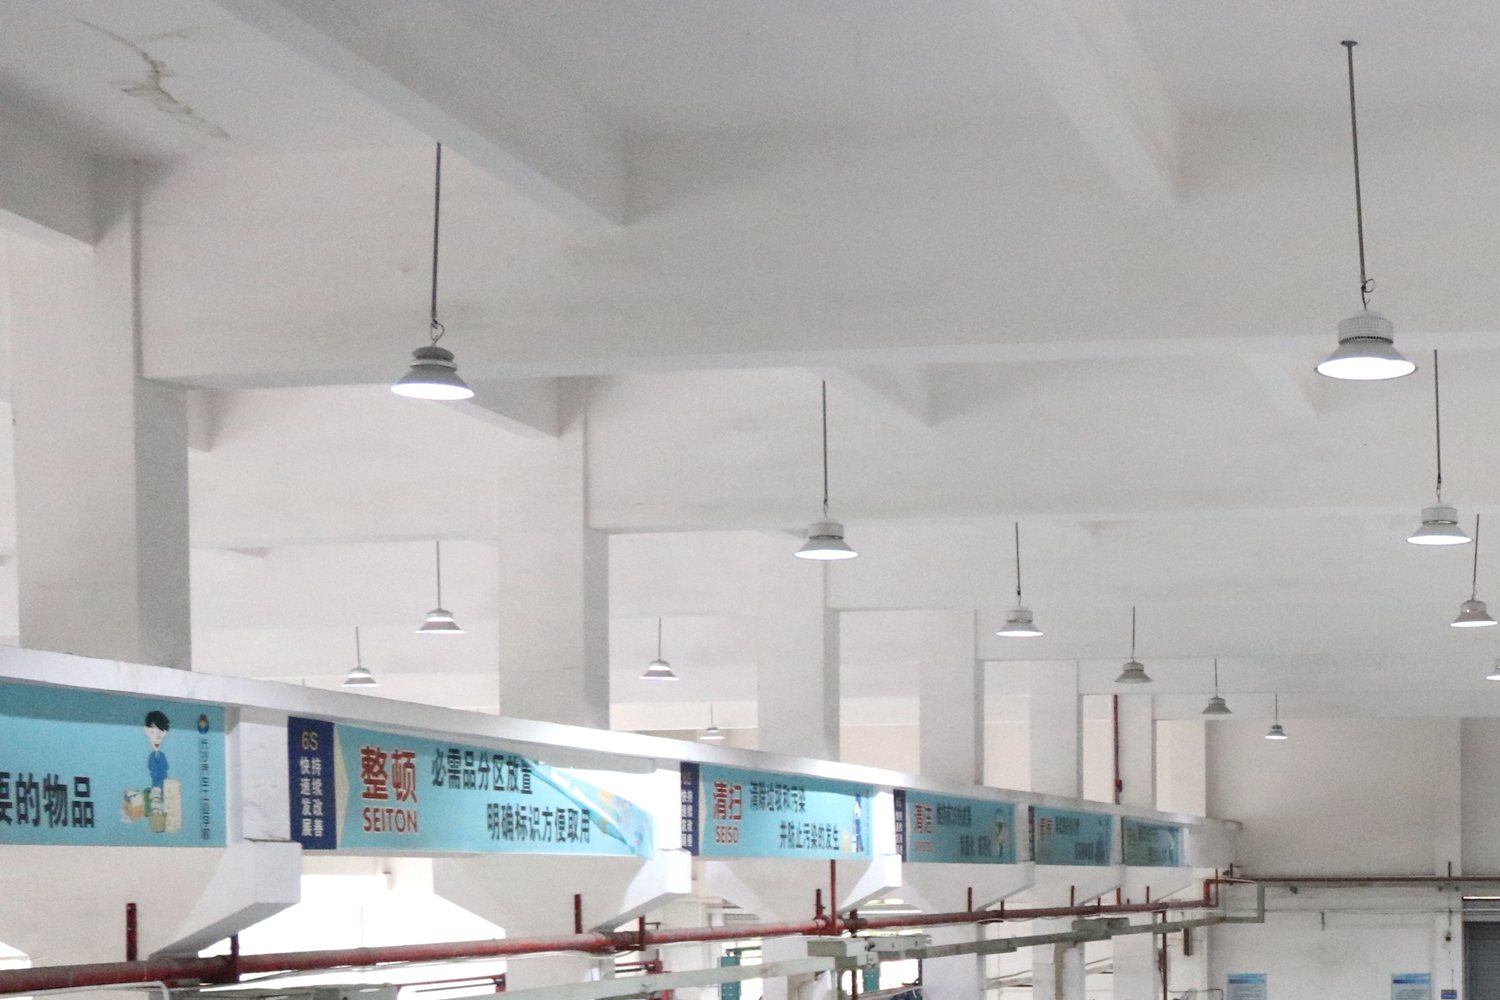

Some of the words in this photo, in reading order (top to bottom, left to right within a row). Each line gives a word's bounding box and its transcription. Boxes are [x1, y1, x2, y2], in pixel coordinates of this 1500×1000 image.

[301, 731, 319, 751] 6S
[361, 746, 418, 803] 整顿
[432, 748, 533, 795] 必需品分区放置
[362, 807, 418, 833] SEITON
[713, 781, 742, 821] 清扫
[487, 803, 591, 843] 明确标识方便取用
[715, 825, 739, 844] SEISO
